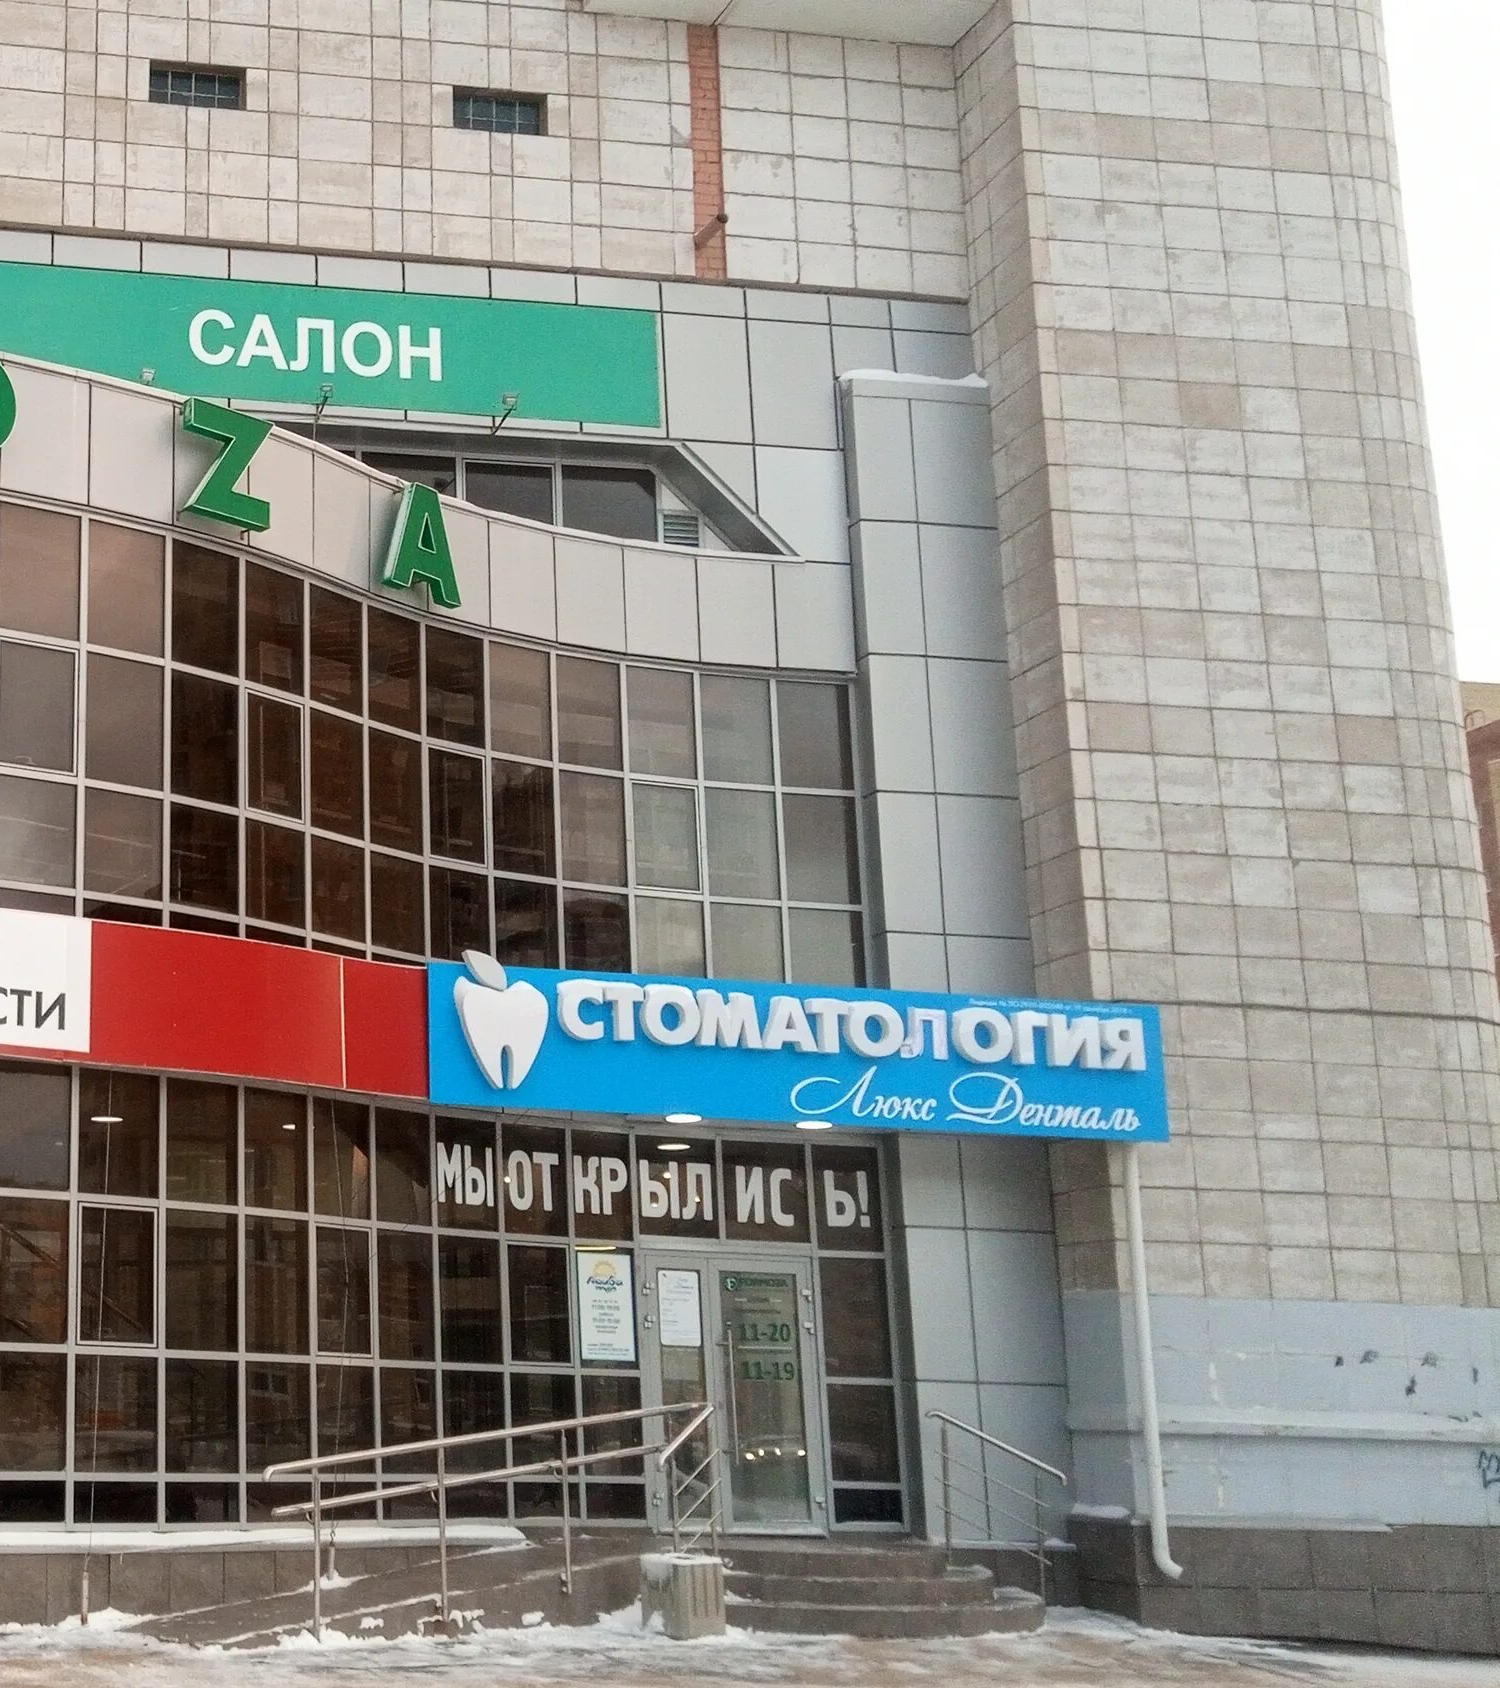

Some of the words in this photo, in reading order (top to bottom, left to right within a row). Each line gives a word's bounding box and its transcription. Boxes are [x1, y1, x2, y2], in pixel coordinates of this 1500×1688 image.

[189, 308, 443, 382] САЛОН
[556, 979, 1147, 1071] СТОМАТОЛОГИЯ
[791, 1066, 936, 1123] Люкс
[947, 1072, 1141, 1132] Денталь
[437, 1141, 494, 1208] МЫ
[741, 1361, 795, 1380] 11-19
